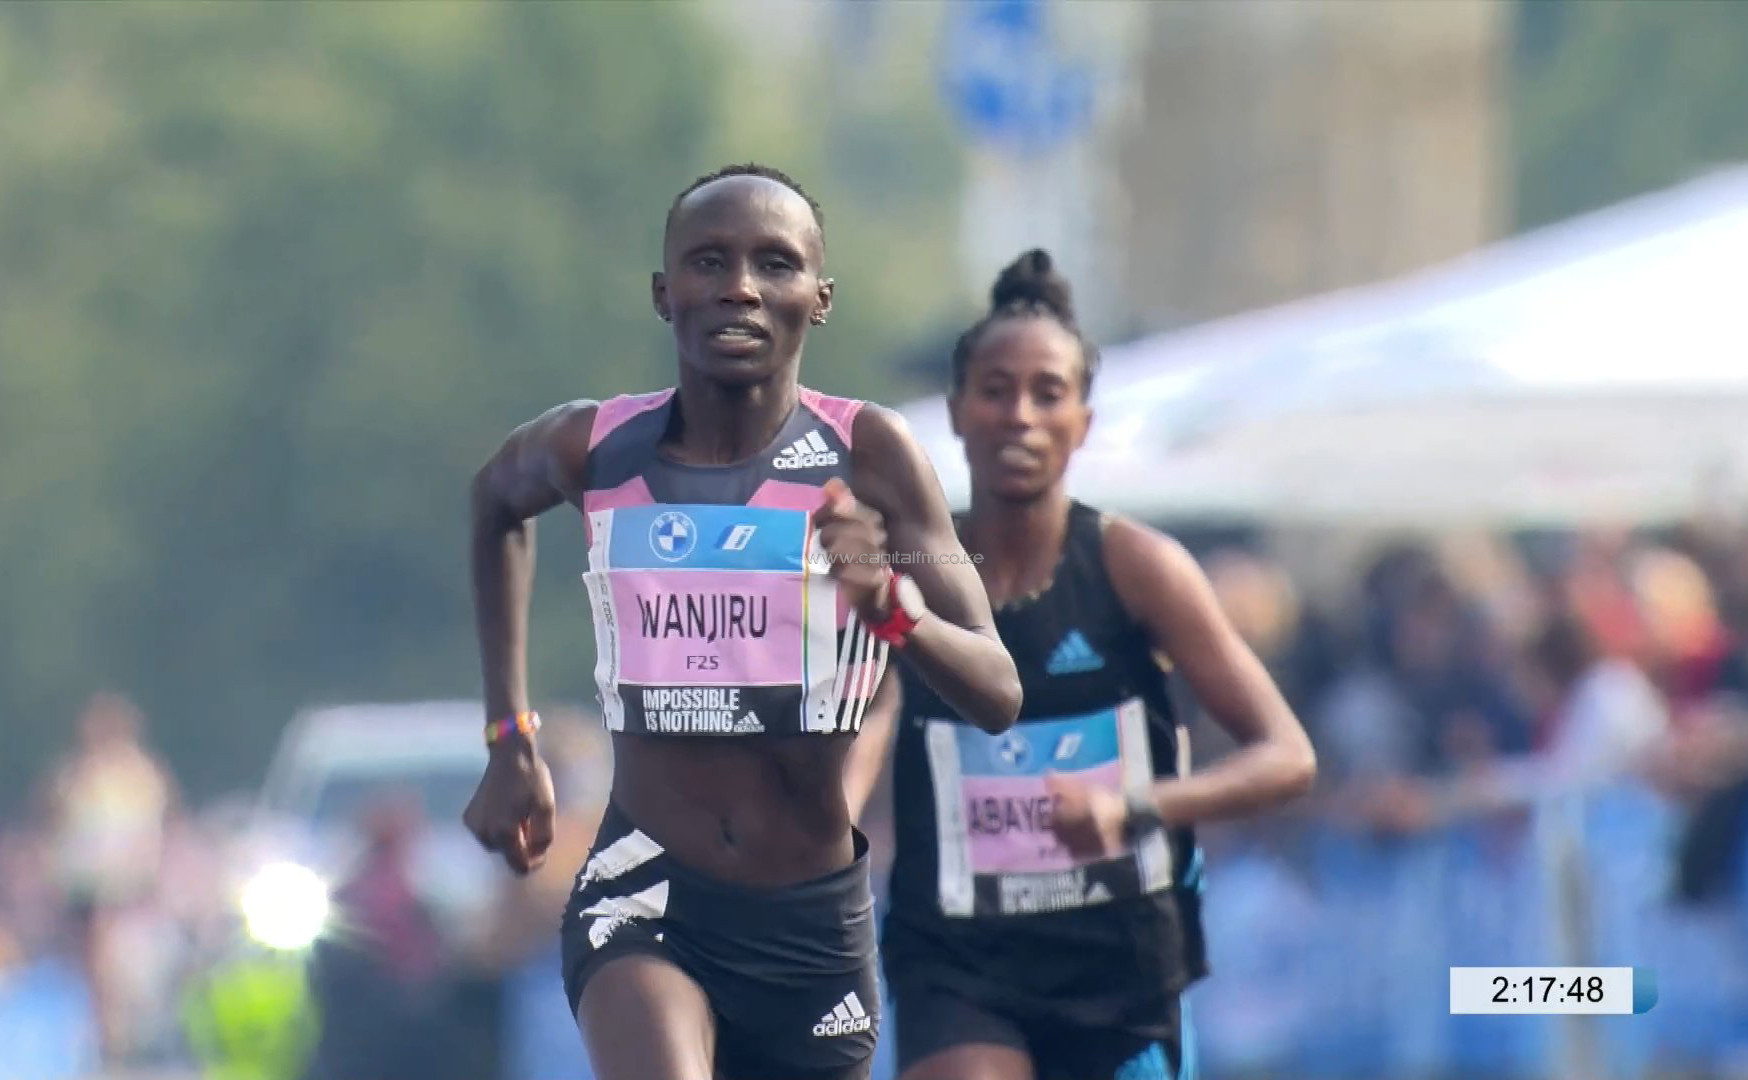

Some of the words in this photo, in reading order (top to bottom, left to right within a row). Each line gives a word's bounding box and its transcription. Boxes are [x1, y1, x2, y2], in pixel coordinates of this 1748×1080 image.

[773, 450, 839, 470] adidas
[636, 593, 767, 643] WANJIRU
[686, 655, 719, 670] F25
[642, 688, 741, 711] IMPOSSIBLE
[644, 711, 659, 732] IS
[659, 711, 735, 733] NOTHING
[967, 795, 1061, 835] ABAYE
